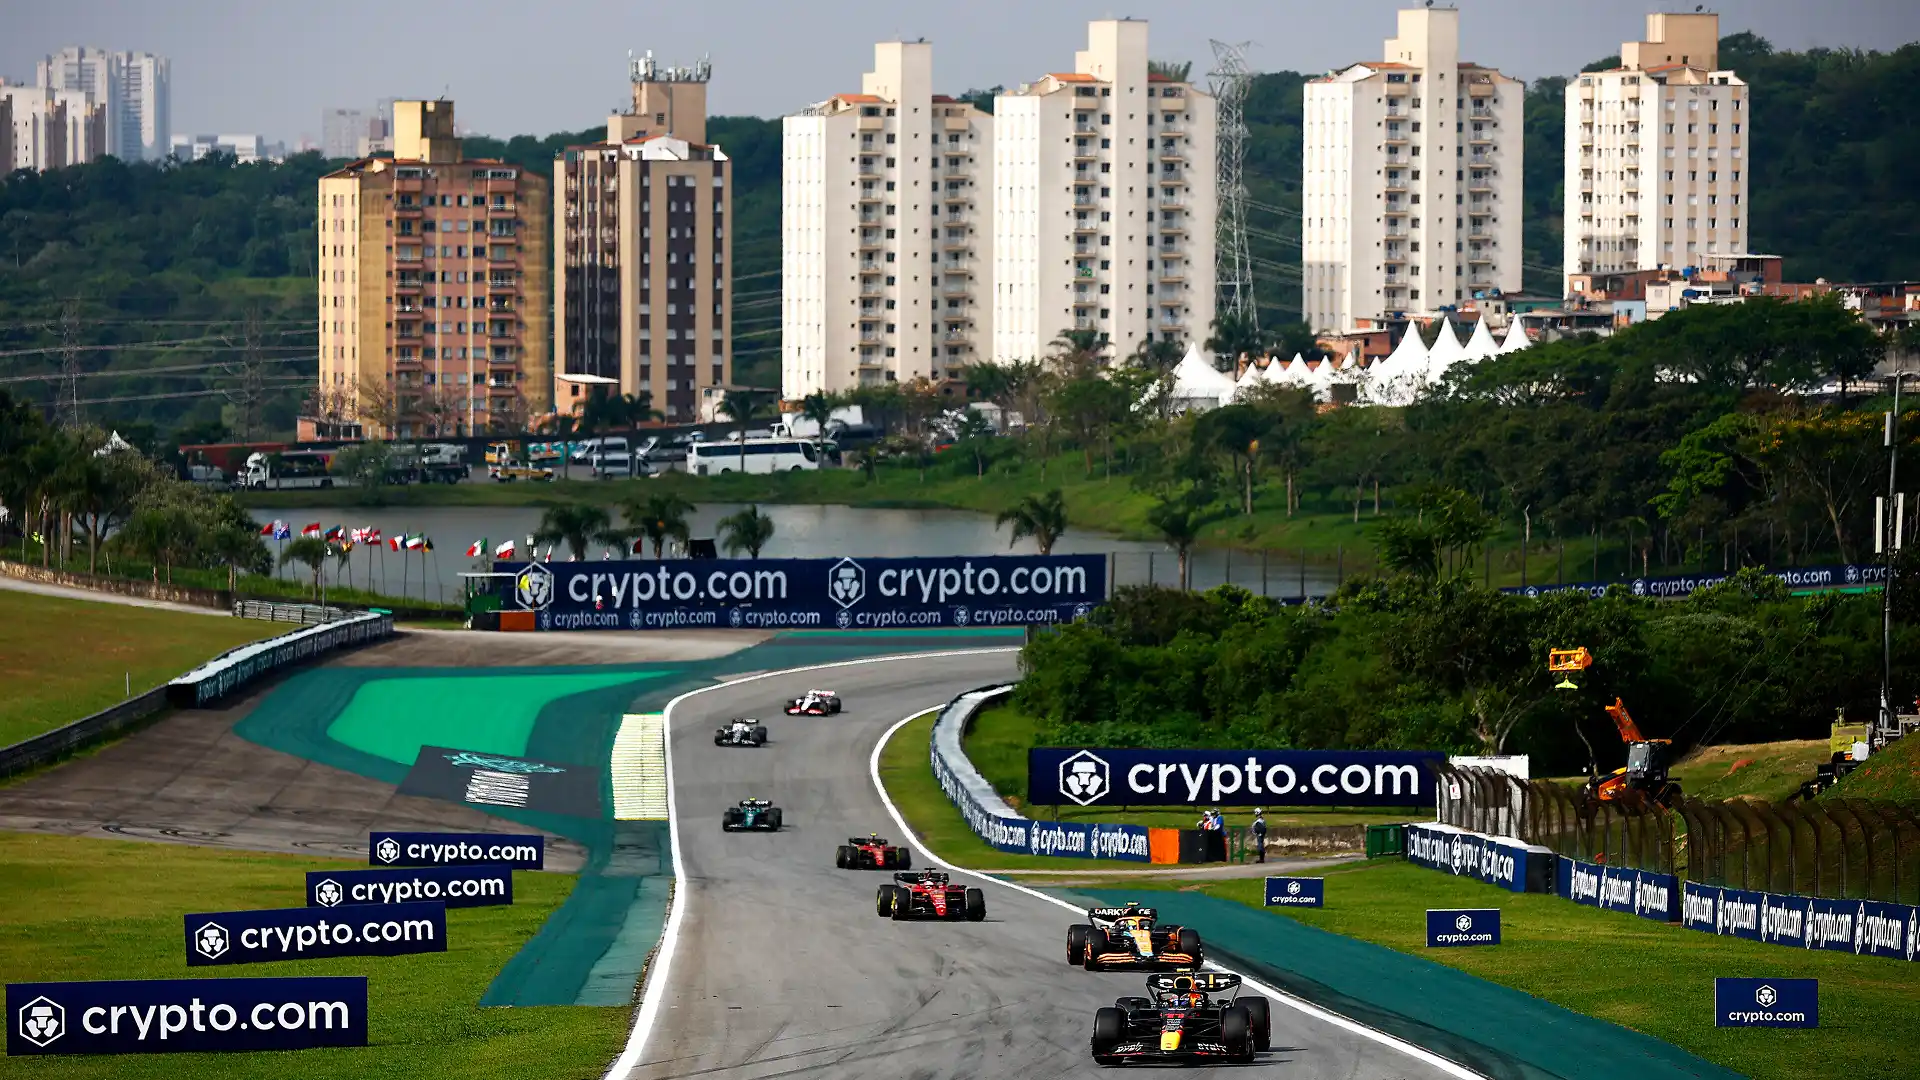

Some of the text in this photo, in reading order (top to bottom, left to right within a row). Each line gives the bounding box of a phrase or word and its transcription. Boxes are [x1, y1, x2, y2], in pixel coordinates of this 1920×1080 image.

[569, 566, 787, 608] crypto.com
[879, 562, 1086, 603] crypto.com
[555, 611, 619, 628] crypto.com
[645, 609, 717, 627] crypto.com
[745, 608, 821, 627] crypto.com
[856, 608, 941, 627] crypto.com
[973, 607, 1057, 626] crypto.com
[1128, 757, 1419, 802] crypto.com
[407, 842, 537, 863] crypto.com
[351, 878, 505, 903] crypto.com
[1271, 895, 1316, 905] crypto.com
[1768, 902, 1802, 941] crypto.com
[1814, 907, 1852, 948] crypto.com
[1865, 911, 1902, 953] crypto.com
[241, 920, 434, 952] crypto.com
[1437, 931, 1492, 943] crypto.com
[82, 998, 349, 1040] crypto.com
[1728, 1004, 1805, 1023] crypto.com
